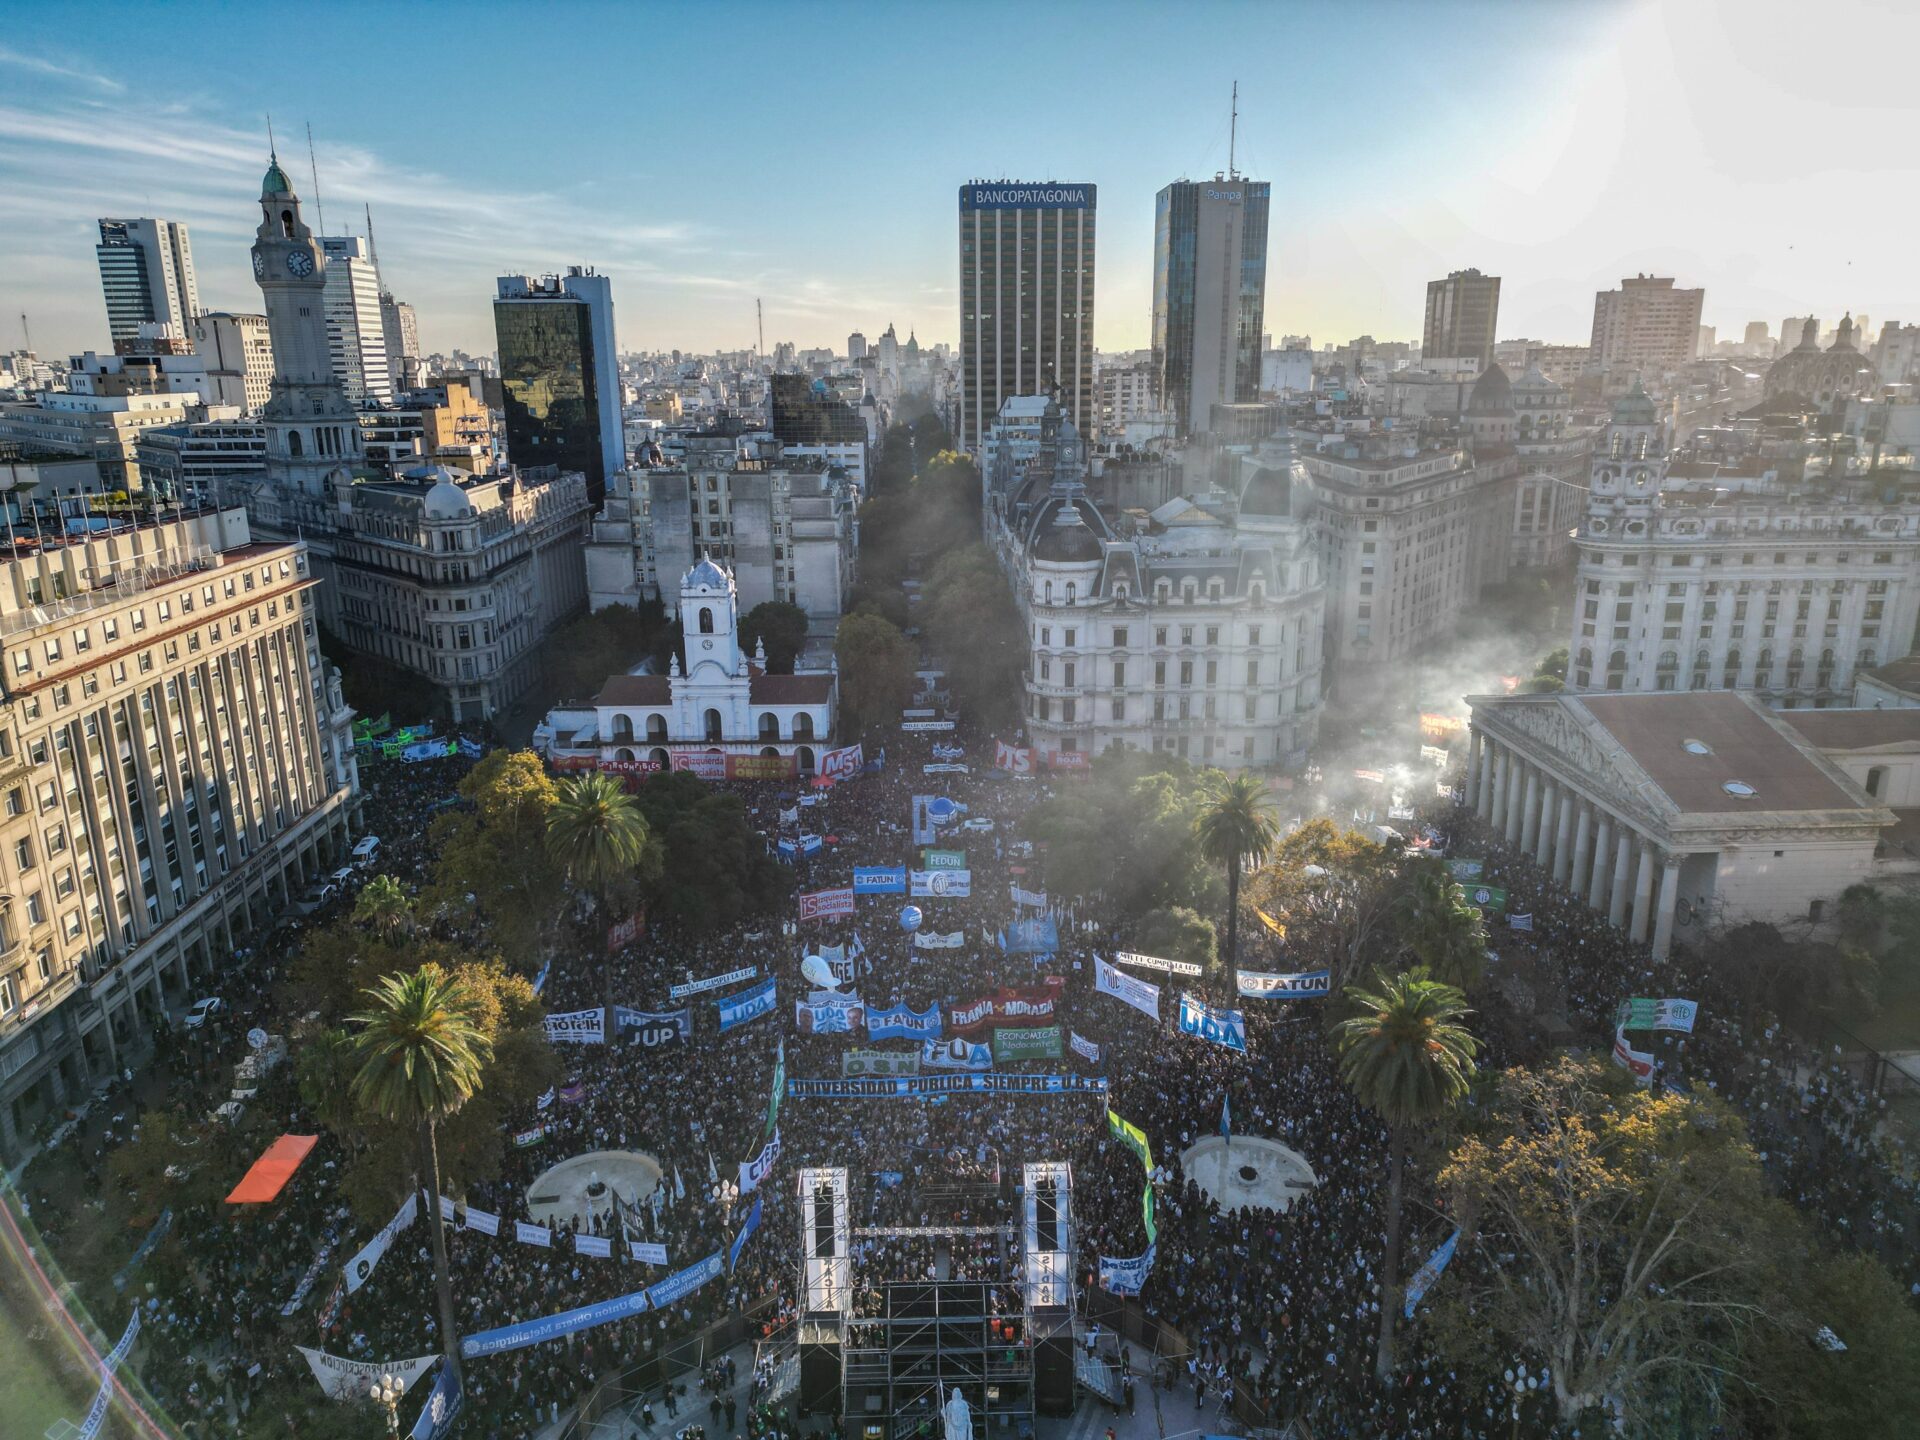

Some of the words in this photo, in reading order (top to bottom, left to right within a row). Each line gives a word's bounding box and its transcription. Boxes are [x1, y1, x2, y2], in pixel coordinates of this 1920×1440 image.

[1207, 189, 1241, 203] Pampa
[689, 756, 724, 768] izquierda
[735, 757, 793, 768] PARTIDO
[930, 855, 960, 866] FEDUN
[866, 875, 894, 884] FATUN
[817, 892, 852, 904] izquierda
[1262, 976, 1328, 990] FATUN
[733, 997, 768, 1021] UDA
[814, 1006, 846, 1021] UDA
[952, 1000, 994, 1024] FRANJA
[1005, 1000, 1054, 1015] MORADA
[883, 1014, 925, 1030] FATUN
[1180, 1005, 1245, 1051] UDA
[629, 1027, 674, 1047] JUP
[996, 1027, 1060, 1041] ECONOMICAS
[931, 1038, 991, 1066] FUA
[795, 1080, 897, 1095] UNIVERSIDAD
[983, 1075, 1049, 1090] SIEMPRE
[515, 1127, 542, 1145] EPA
